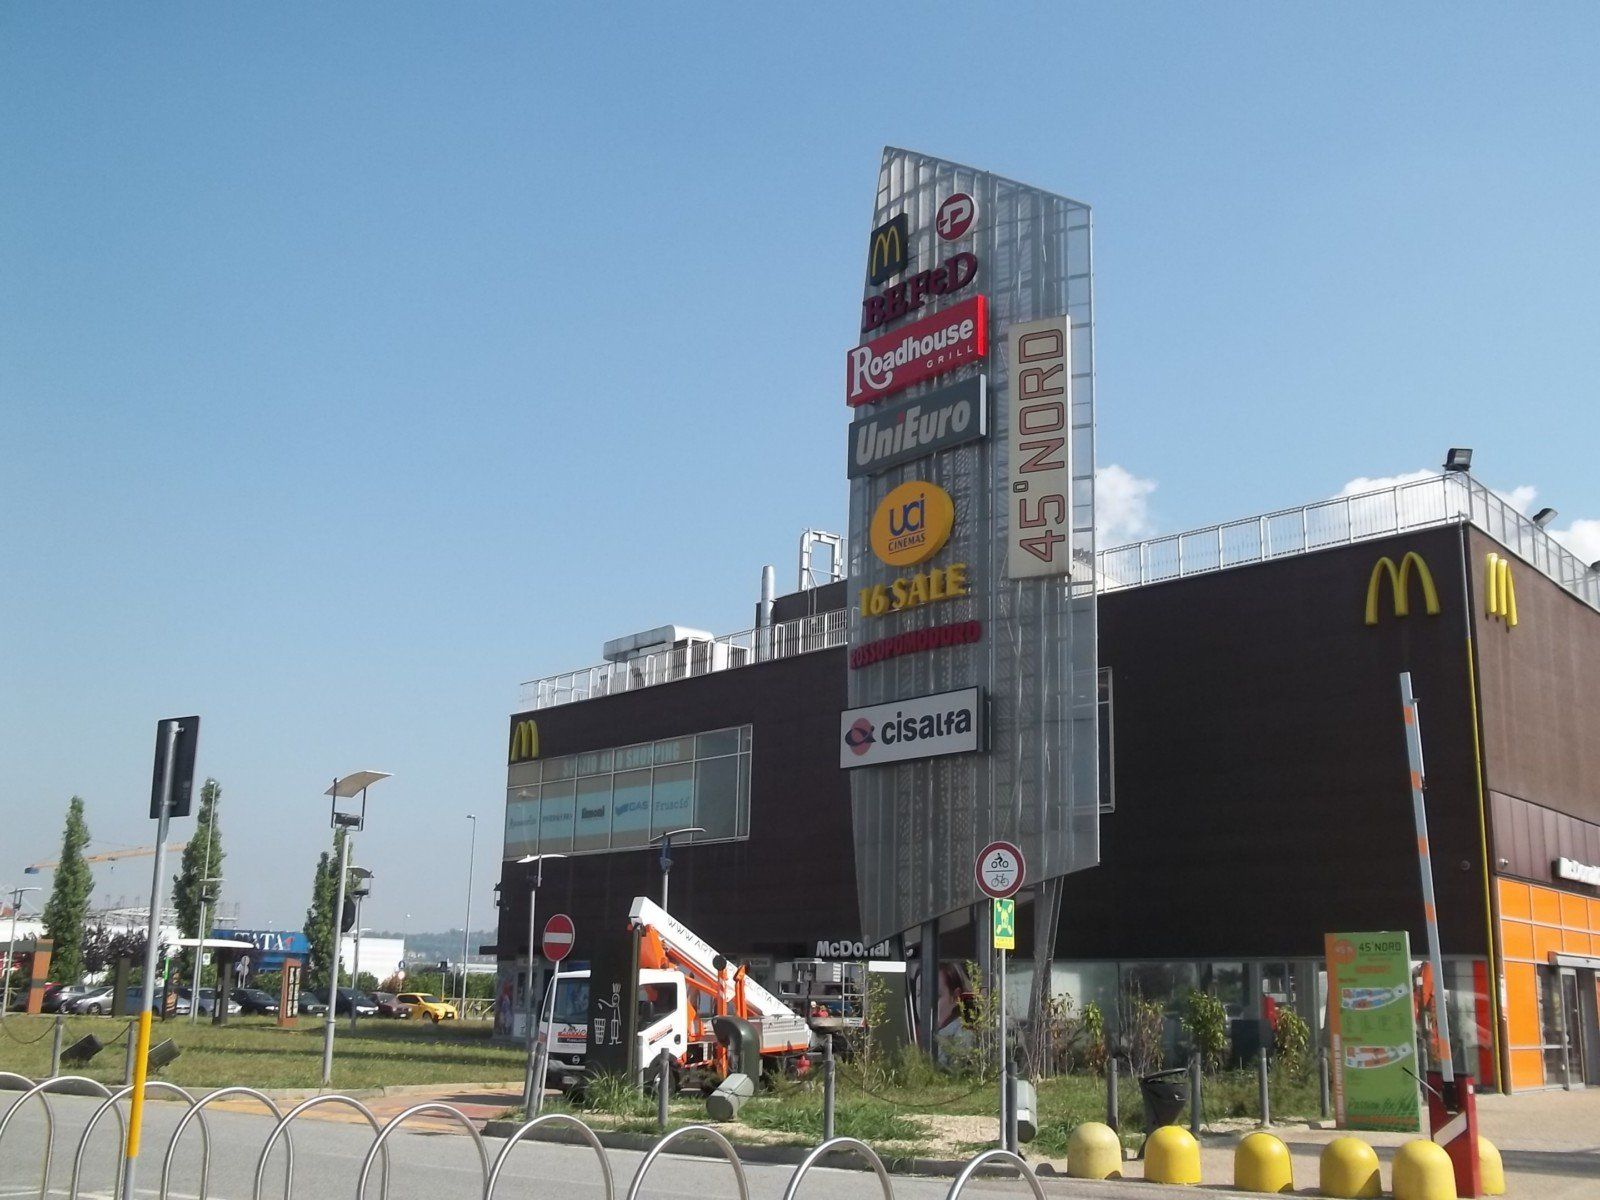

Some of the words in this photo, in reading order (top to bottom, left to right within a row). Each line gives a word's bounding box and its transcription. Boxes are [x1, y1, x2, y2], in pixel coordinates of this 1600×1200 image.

[850, 318, 974, 398] Roadhouse
[926, 344, 973, 369] GRILL
[856, 400, 971, 466] UniEuro
[887, 532, 926, 552] CINEMAS
[891, 562, 968, 610] SALE
[881, 708, 972, 745] cisalfa
